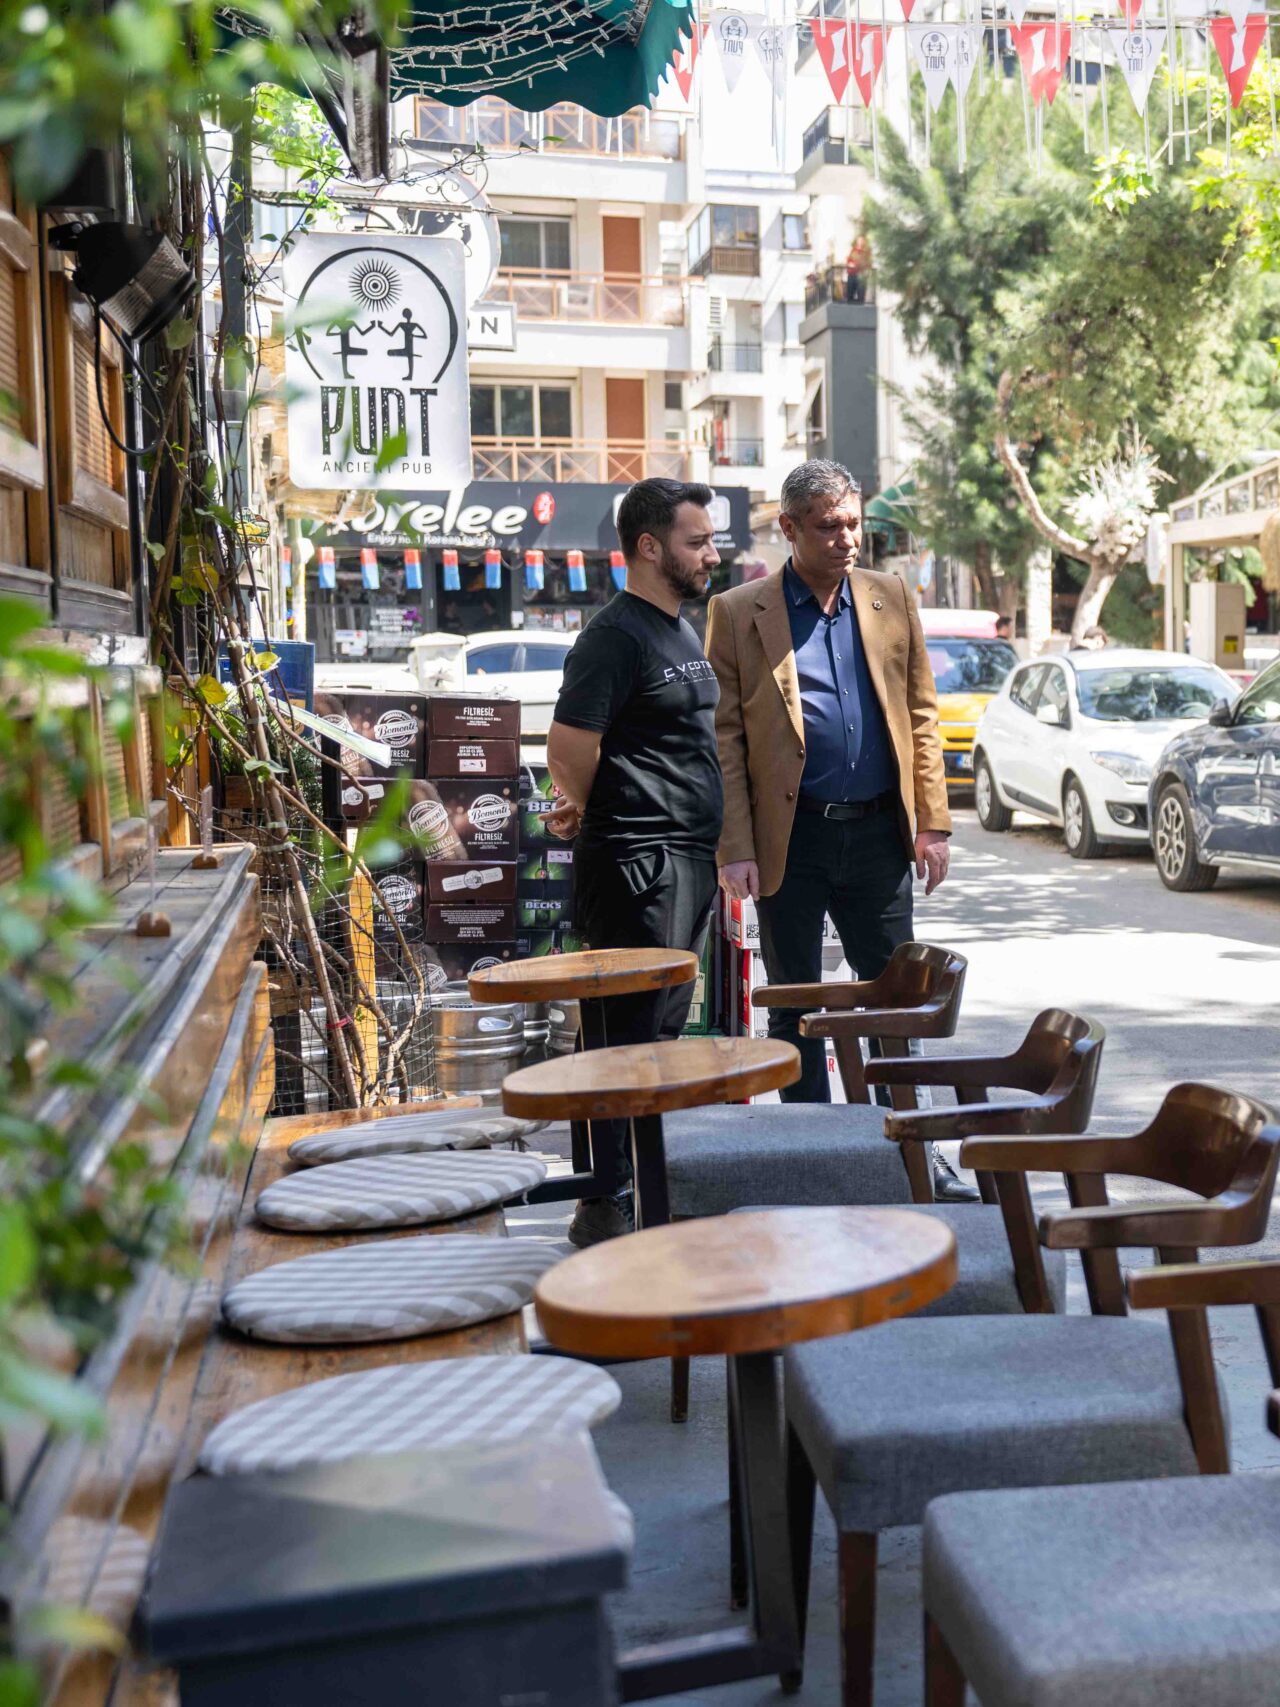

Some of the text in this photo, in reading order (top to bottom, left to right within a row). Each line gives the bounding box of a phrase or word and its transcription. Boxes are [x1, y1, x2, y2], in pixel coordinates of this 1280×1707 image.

[320, 385, 438, 458] PUNT
[402, 462, 432, 475] PUB
[309, 486, 528, 537] orelee
[463, 706, 495, 717] FİLTRESİZ
[377, 720, 417, 737] Bomonti
[471, 806, 508, 821] Bomonti
[474, 832, 503, 841] FİLTRESİZ
[525, 901, 562, 909] BECK'S
